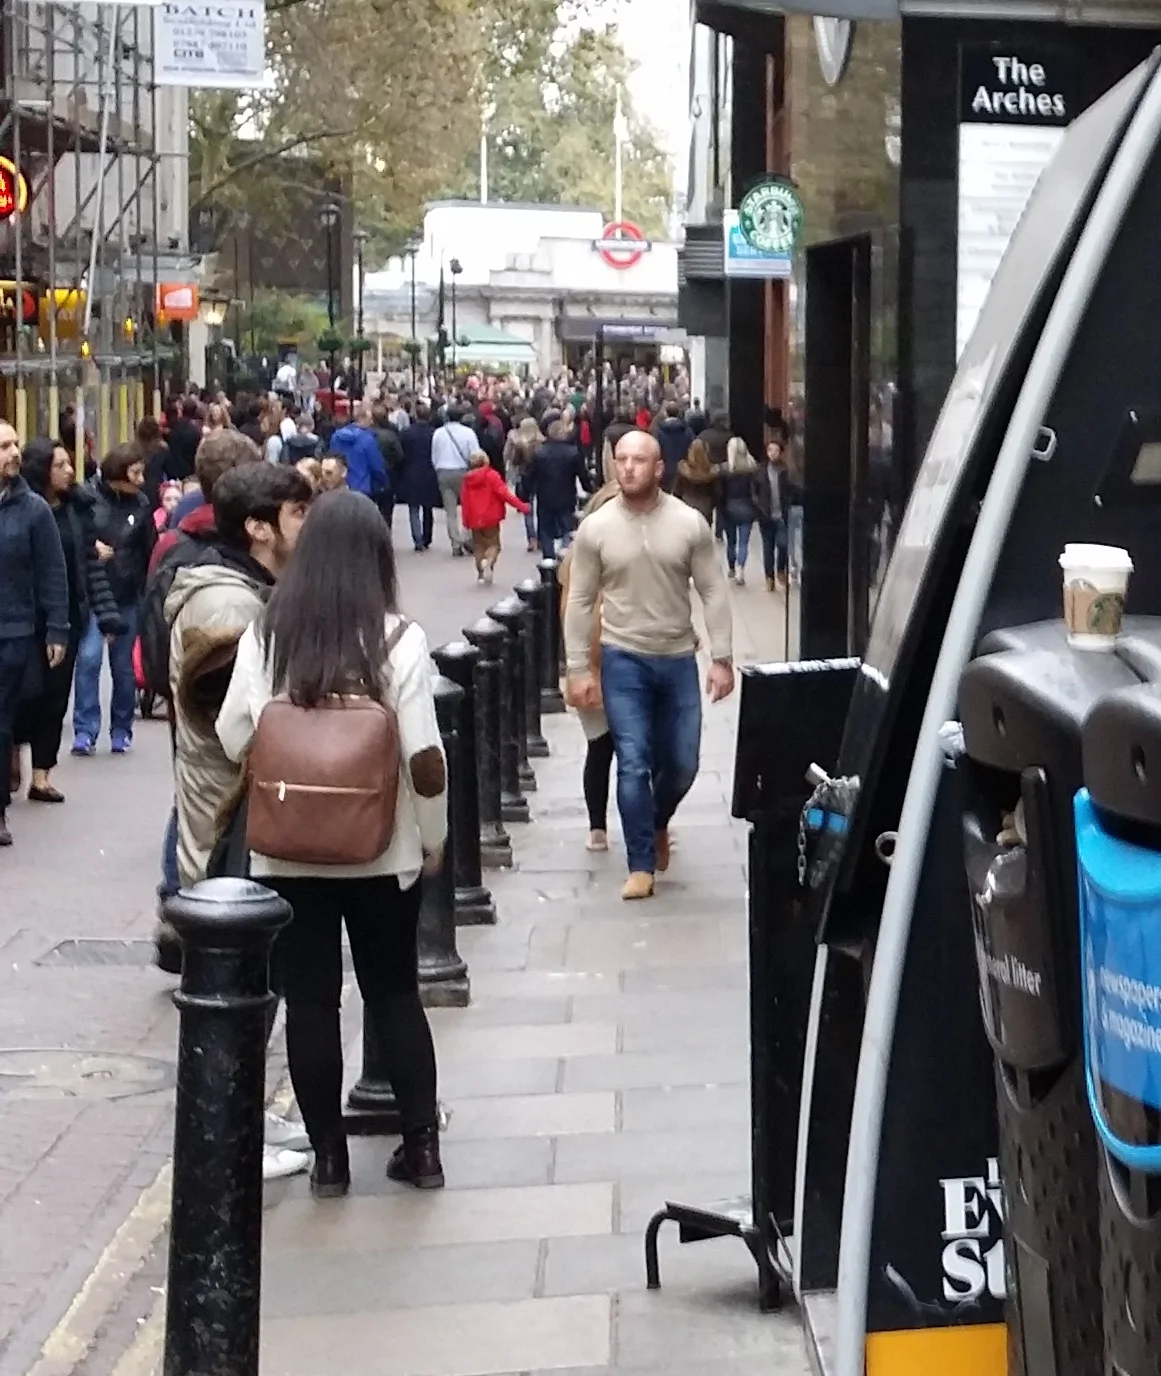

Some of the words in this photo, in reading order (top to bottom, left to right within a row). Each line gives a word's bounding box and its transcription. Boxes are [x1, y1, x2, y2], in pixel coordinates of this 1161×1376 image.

[162, 3, 255, 18] BATCH
[992, 56, 1046, 86] The
[971, 85, 1066, 117] Arches
